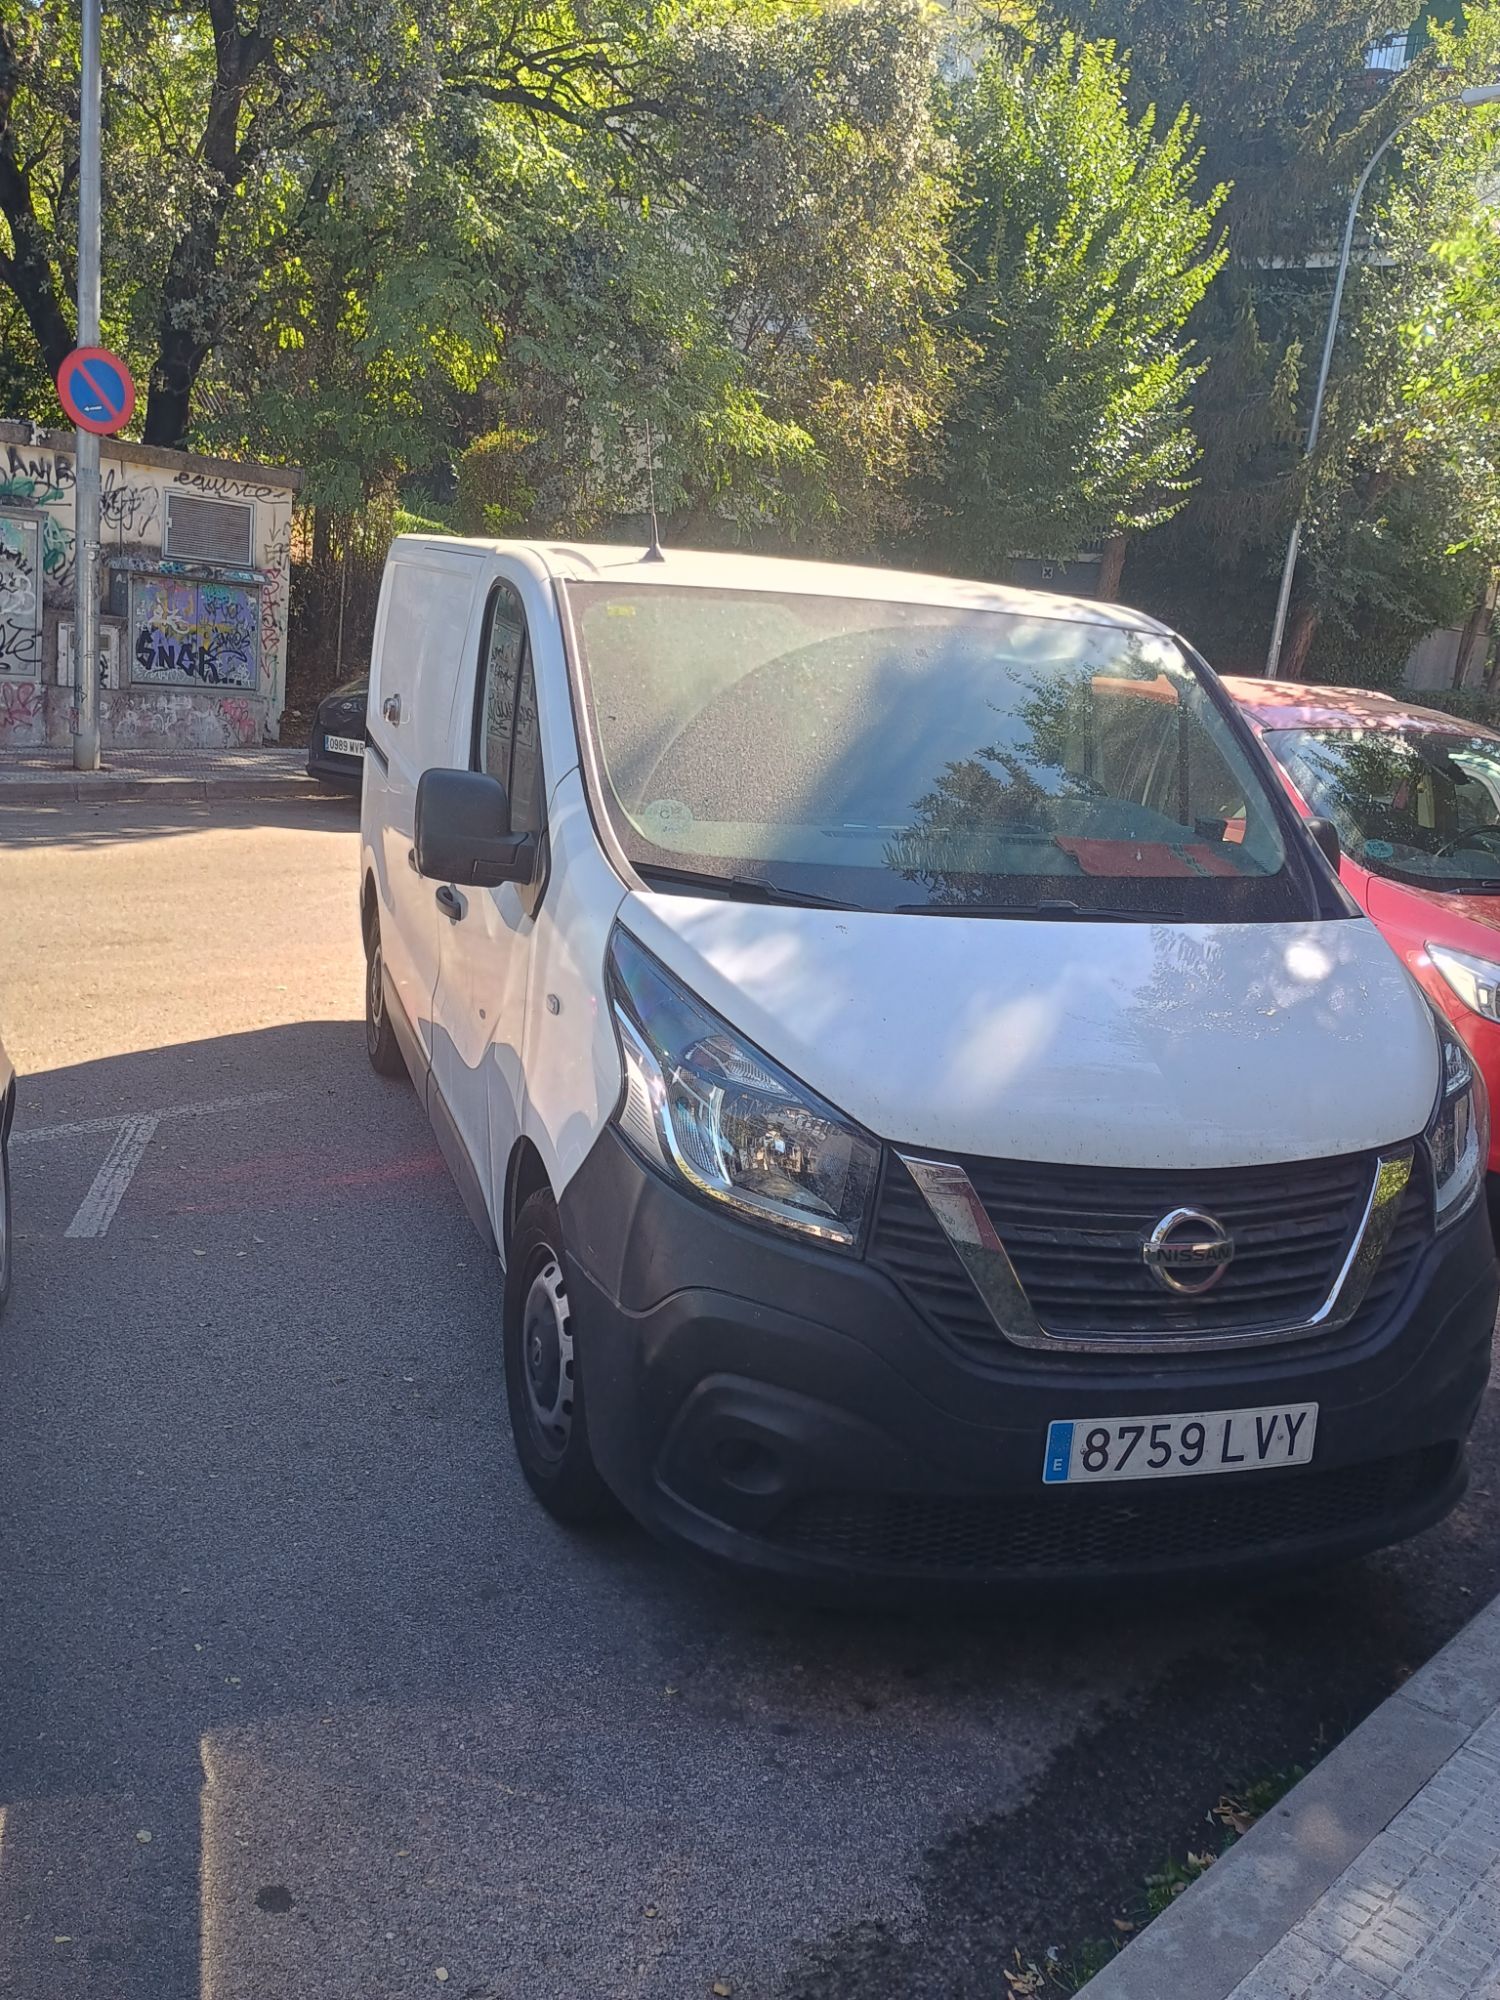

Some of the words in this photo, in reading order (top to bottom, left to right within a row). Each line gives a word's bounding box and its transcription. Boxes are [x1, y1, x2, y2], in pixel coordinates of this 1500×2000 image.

[1156, 1248, 1229, 1262] NISSAN
[1052, 1458, 1063, 1472] E
[1082, 1422, 1206, 1472] 8759
[1221, 1412, 1307, 1463] LVY
